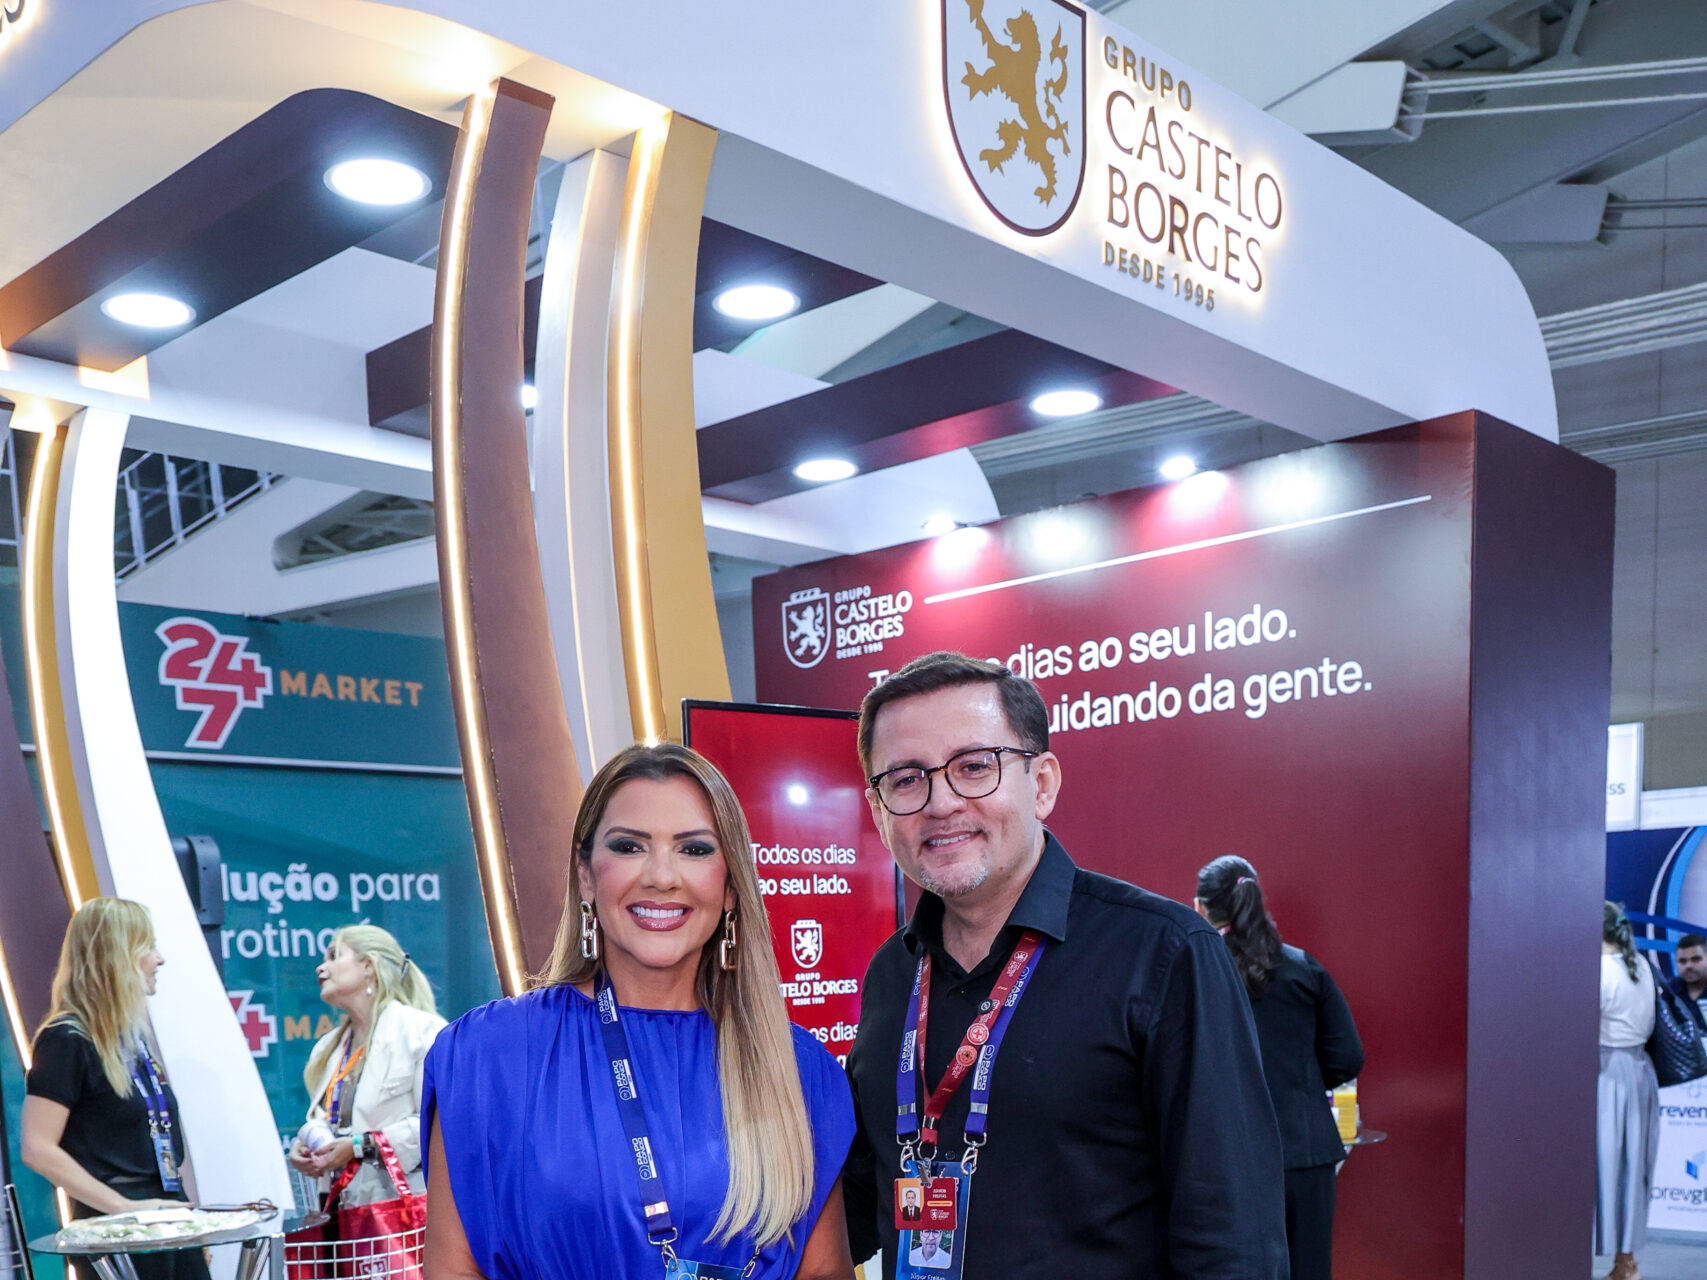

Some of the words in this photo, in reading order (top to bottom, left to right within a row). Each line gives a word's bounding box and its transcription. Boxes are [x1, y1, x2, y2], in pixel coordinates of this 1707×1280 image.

[1104, 35, 1192, 112] GRUPO
[1105, 90, 1283, 230] CASTELO
[1107, 164, 1263, 293] BORGES
[1104, 241, 1165, 290] DESDE
[1174, 273, 1215, 311] 1995
[834, 585, 872, 604] GRUPO
[834, 590, 913, 625] CASTELO
[836, 615, 904, 648] BORGES
[1007, 642, 1073, 680] dias
[1078, 636, 1123, 672] ao
[1128, 623, 1196, 664] seu
[1204, 603, 1297, 652] lado.
[155, 617, 272, 709] 24
[279, 669, 424, 707] MARKET
[1048, 681, 1182, 734] uidando
[1188, 672, 1236, 715] da
[1243, 657, 1372, 719] gente.
[176, 688, 246, 750] 7
[750, 842, 800, 865] Todos
[801, 847, 822, 864] os
[823, 844, 856, 864] dias
[220, 862, 340, 914] lução
[350, 872, 441, 913] para
[758, 878, 778, 896] ao
[780, 878, 811, 895] seu
[813, 873, 852, 894] lado.
[780, 981, 812, 998] TELO
[812, 979, 858, 996] BORGES
[795, 972, 821, 981] GRUPO
[612, 1060, 624, 1087] PAPO
[631, 1137, 644, 1166] PAPO
